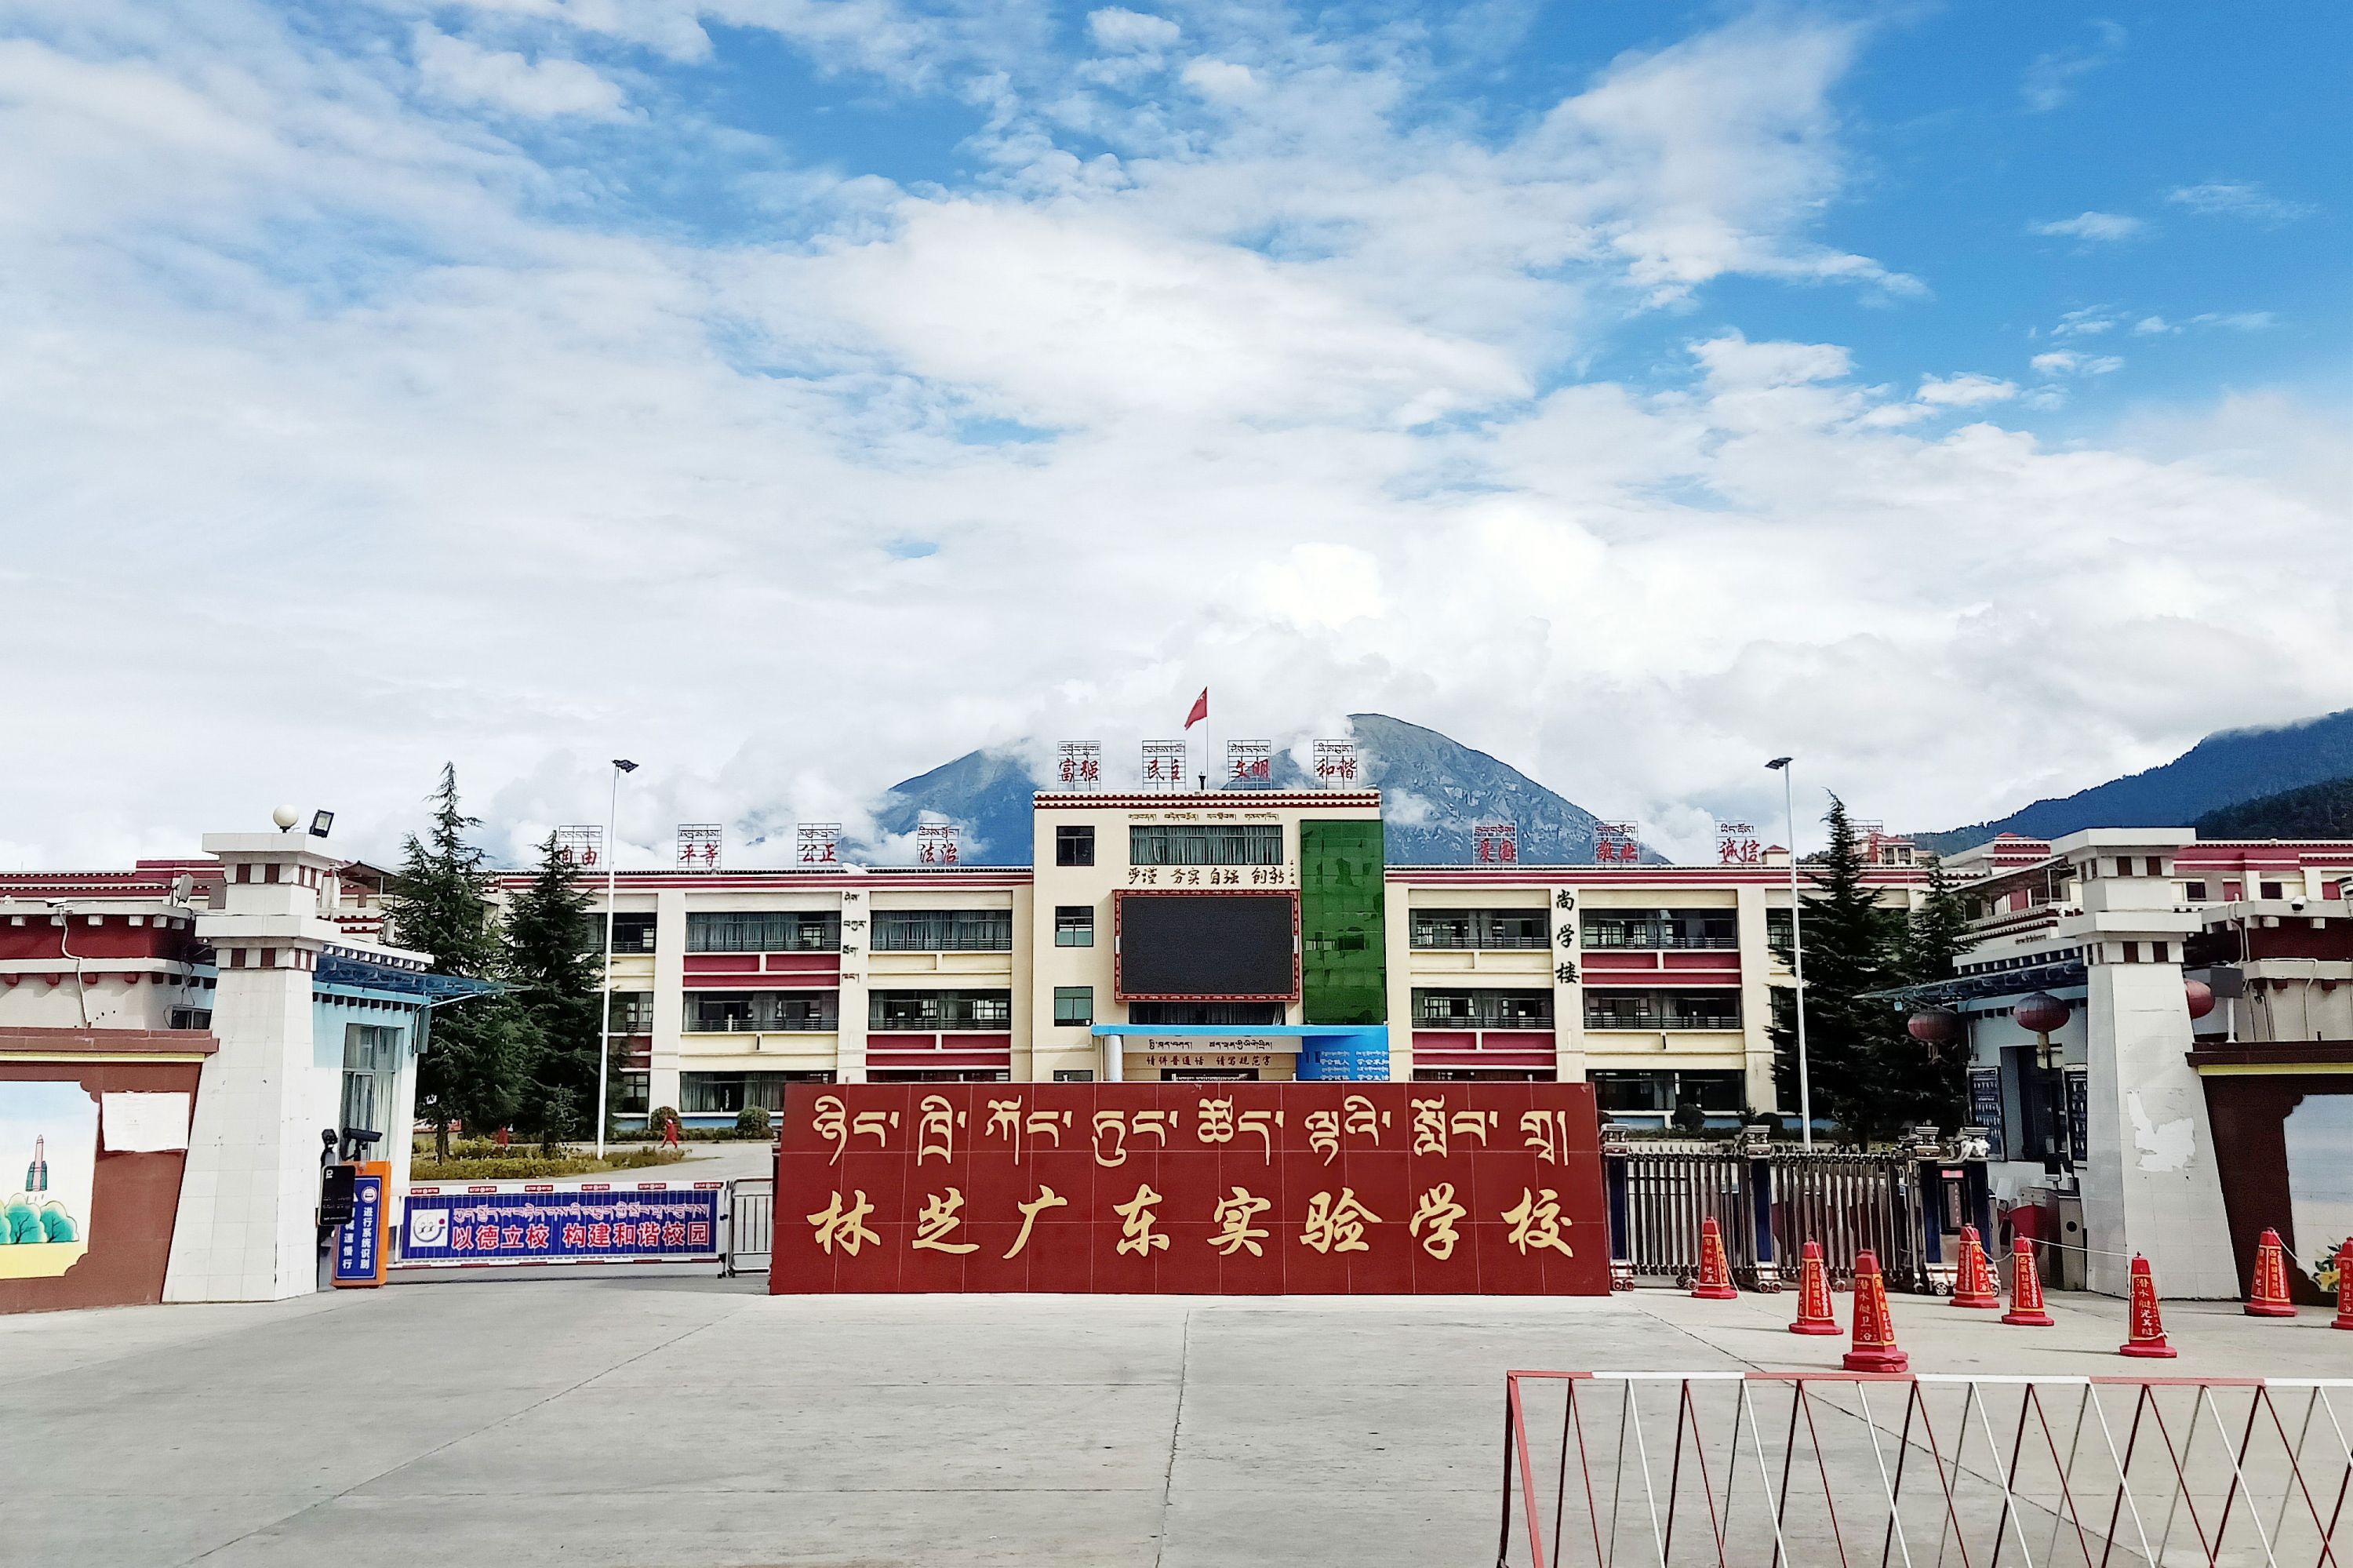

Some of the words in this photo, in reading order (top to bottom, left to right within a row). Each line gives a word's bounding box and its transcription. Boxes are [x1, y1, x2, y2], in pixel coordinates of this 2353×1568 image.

[1059, 758, 1099, 783] 富强
[1148, 759, 1180, 780] 民主
[1231, 759, 1269, 780] 文明
[1317, 758, 1356, 780] 和谐
[560, 845, 598, 866] 自由
[680, 842, 718, 867] 平等
[800, 843, 837, 862] 公正
[920, 842, 957, 863] 法治
[1478, 838, 1515, 862] 爱国
[1596, 840, 1638, 862] 敬业
[1719, 837, 1760, 863] 诚信
[1128, 867, 1158, 885] 严谨
[1170, 868, 1200, 885] 务实
[1209, 868, 1239, 885] 自强
[1251, 866, 1285, 885] 创新
[1555, 889, 1580, 984] 尚学楼
[1147, 1056, 1204, 1066] 请讲普通话
[1216, 1056, 1271, 1066] 请写规范字
[806, 1183, 1573, 1260] 林芝广东实验学校
[360, 1206, 374, 1270] 进行系统识别
[452, 1224, 549, 1250] 以德立校
[562, 1222, 710, 1247] 构建和谐校园
[1857, 1279, 1872, 1341] 潜水艇卫浴
